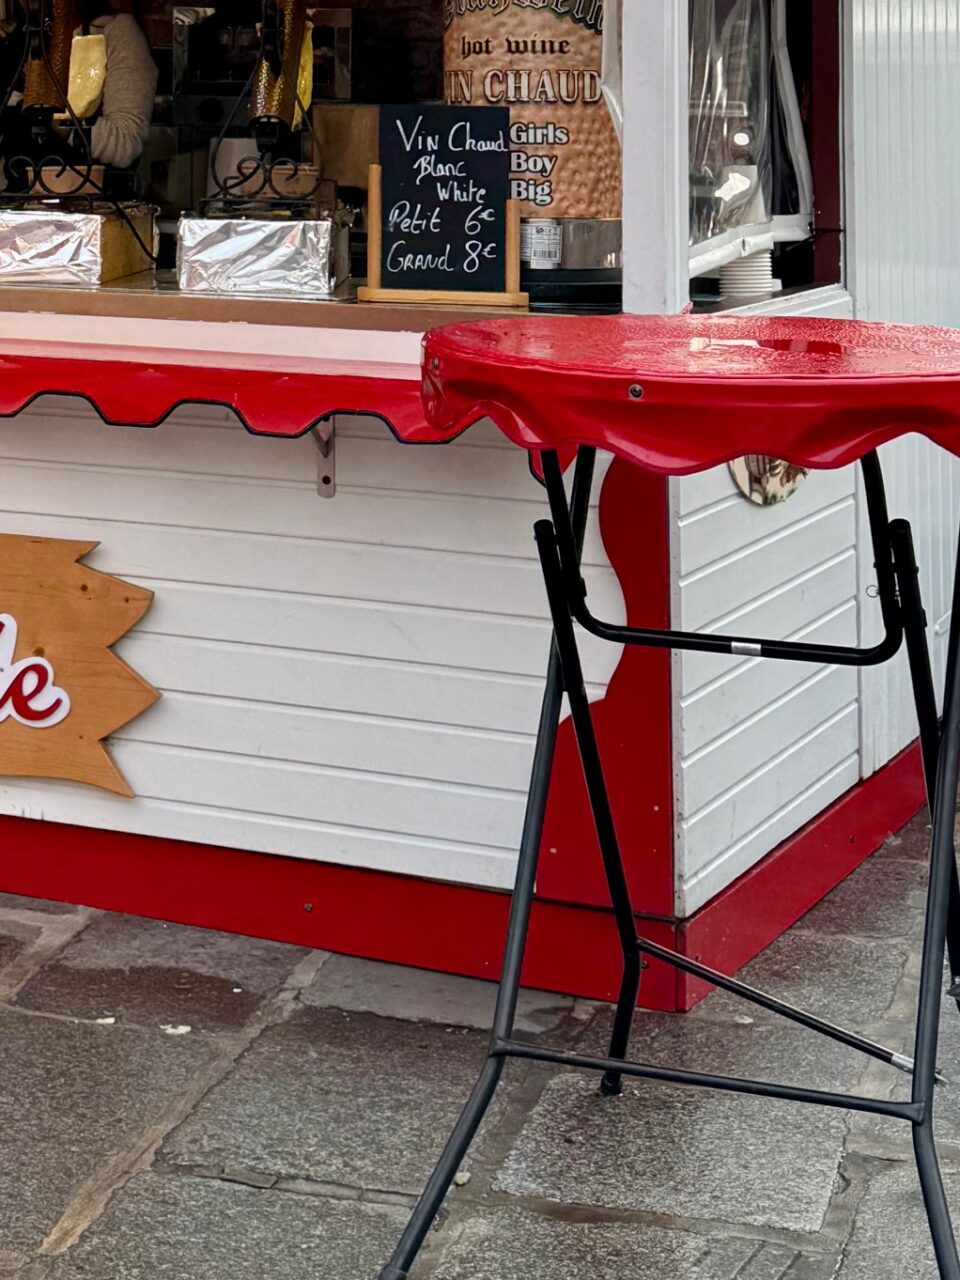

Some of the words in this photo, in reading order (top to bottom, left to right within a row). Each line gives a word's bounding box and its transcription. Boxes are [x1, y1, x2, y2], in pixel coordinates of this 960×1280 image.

[461, 36, 493, 59] hot
[505, 33, 571, 55] wine
[444, 70, 473, 104] IN
[483, 70, 603, 104] CHAUD
[448, 122, 509, 152] Chaud
[510, 122, 570, 145] Girls
[413, 155, 468, 185] Blanc
[510, 152, 558, 176] Boy
[510, 179, 553, 206] Big
[388, 200, 442, 234] Petit
